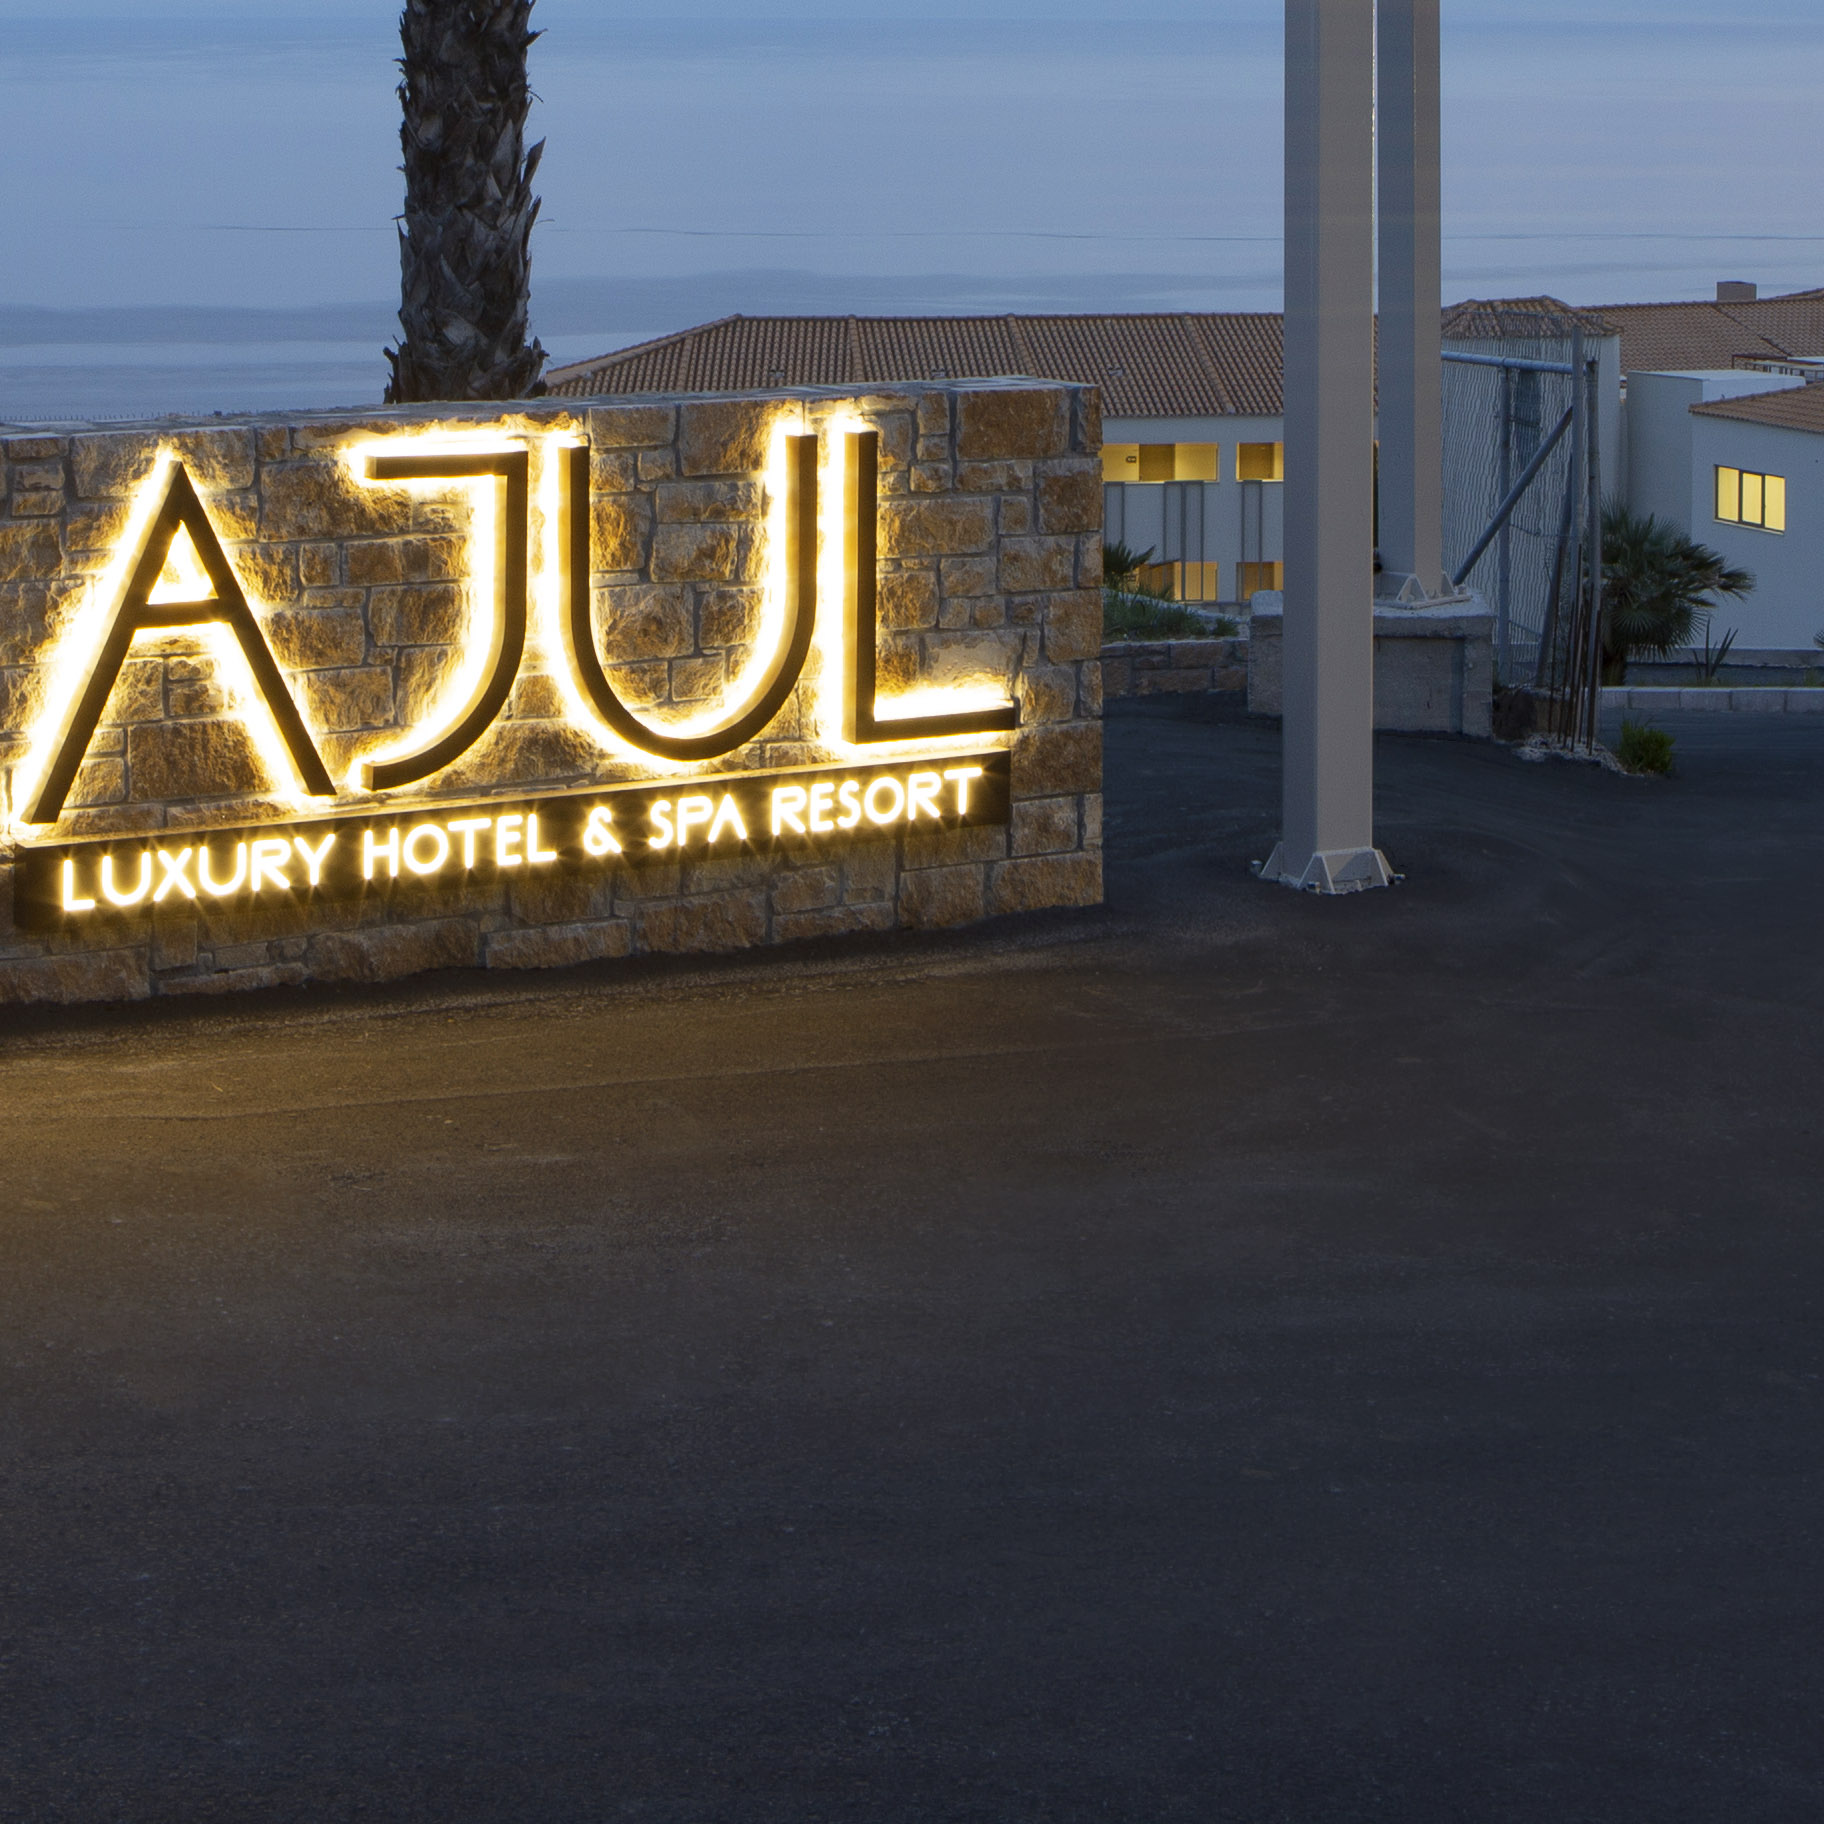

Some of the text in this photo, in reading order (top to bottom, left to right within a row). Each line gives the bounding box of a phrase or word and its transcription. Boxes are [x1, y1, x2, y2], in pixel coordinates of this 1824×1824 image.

[21, 430, 1016, 824] AJUL
[63, 767, 983, 911] LUXURY HOTEL & SPA RESORT
